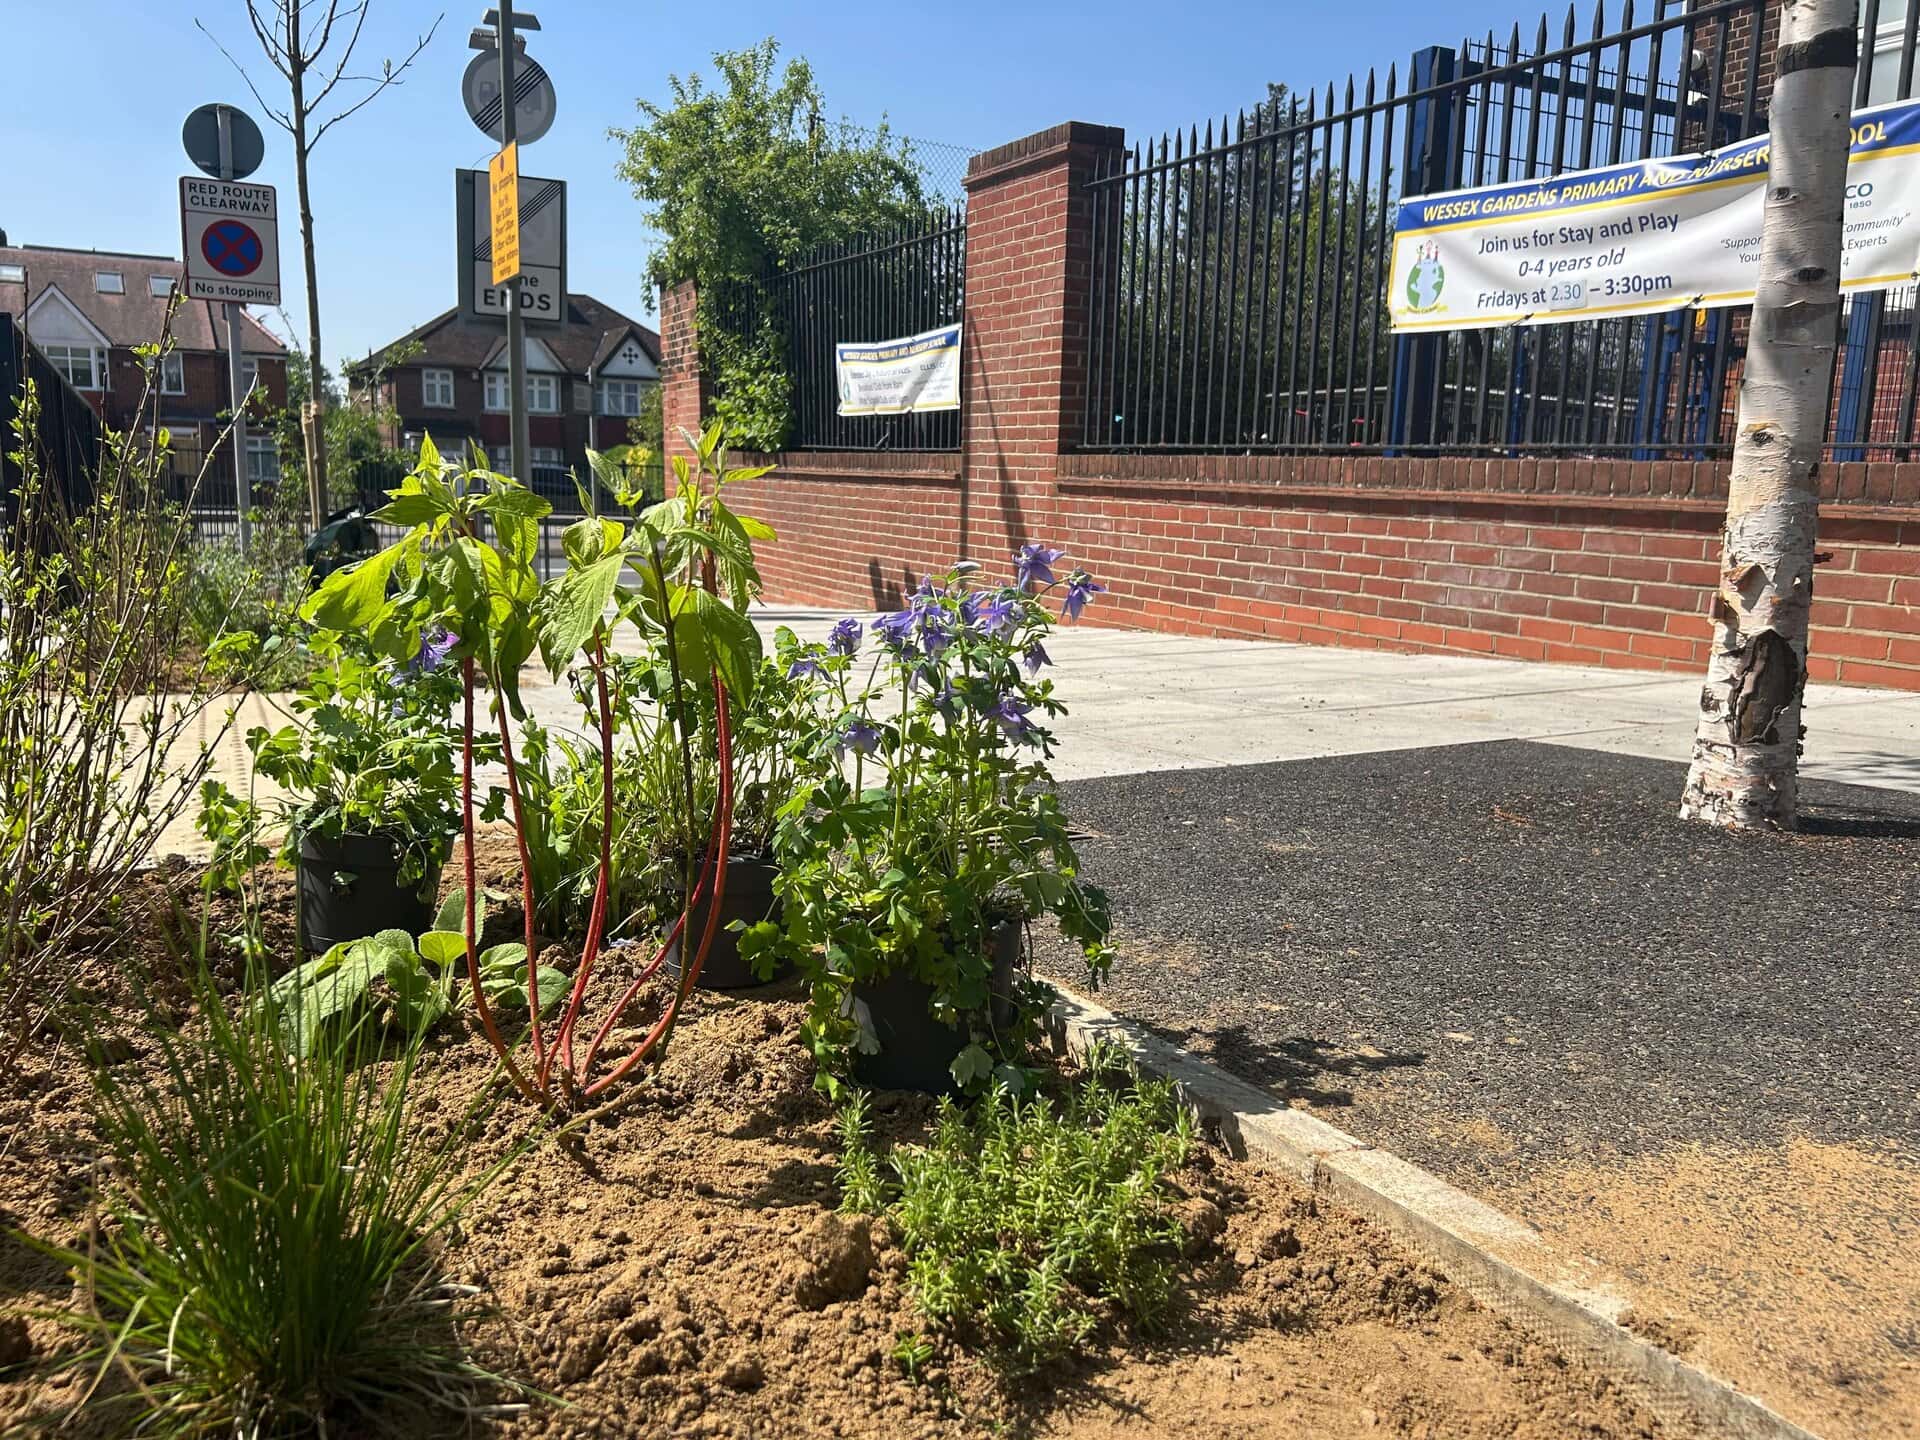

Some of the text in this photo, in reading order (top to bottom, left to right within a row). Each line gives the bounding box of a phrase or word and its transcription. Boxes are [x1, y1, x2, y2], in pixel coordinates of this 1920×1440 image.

[189, 182, 270, 202] RED ROUTE
[1423, 200, 1481, 222] WESSEX
[1482, 189, 1558, 214] GARDENS
[1560, 172, 1638, 205] PRIMARY
[1638, 167, 1686, 188] AND
[1687, 145, 1770, 180] NURSER
[190, 195, 270, 213] CLEARWAY
[1849, 200, 1872, 209] 1850
[1478, 212, 1679, 255] Join us for Stay and Play
[1847, 236, 1888, 251] Experts
[1518, 247, 1625, 278] 0-4 years old
[518, 275, 539, 287] ne
[195, 282, 273, 300] No stopping
[1477, 291, 1528, 310] Fridays
[1532, 289, 1546, 304] at
[1551, 283, 1581, 301] 2.30
[1605, 274, 1673, 297] 3:30pm
